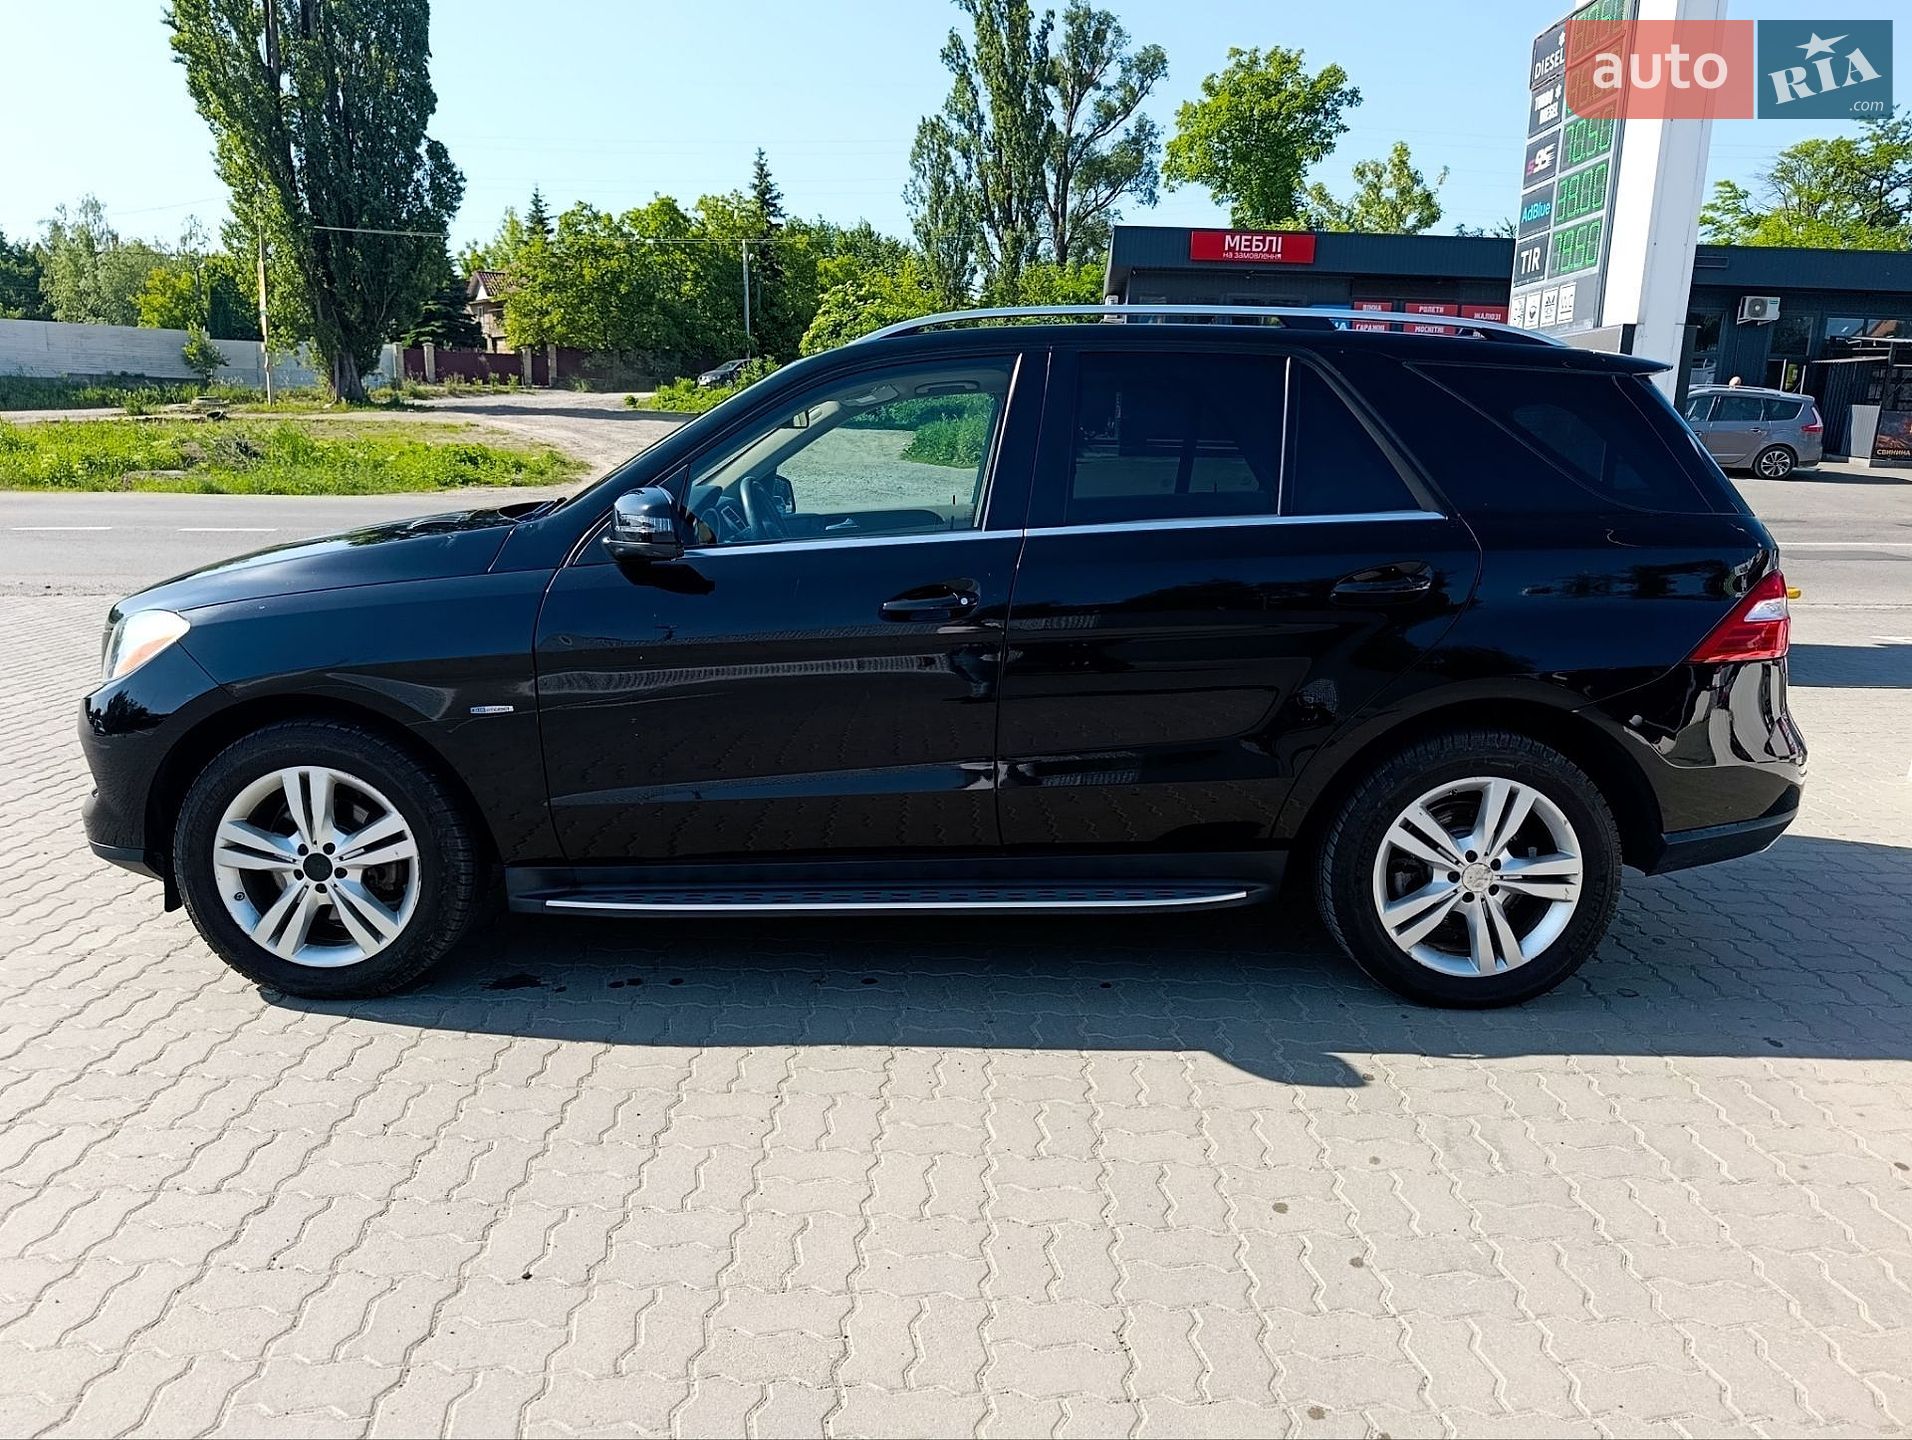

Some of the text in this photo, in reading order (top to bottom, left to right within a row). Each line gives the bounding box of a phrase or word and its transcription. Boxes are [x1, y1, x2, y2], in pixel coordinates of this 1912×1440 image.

[1534, 48, 1565, 80] DIESEL
[1521, 202, 1551, 223] AdBlue
[1224, 235, 1282, 253] МЕБЛІ
[1520, 247, 1541, 275] TIR
